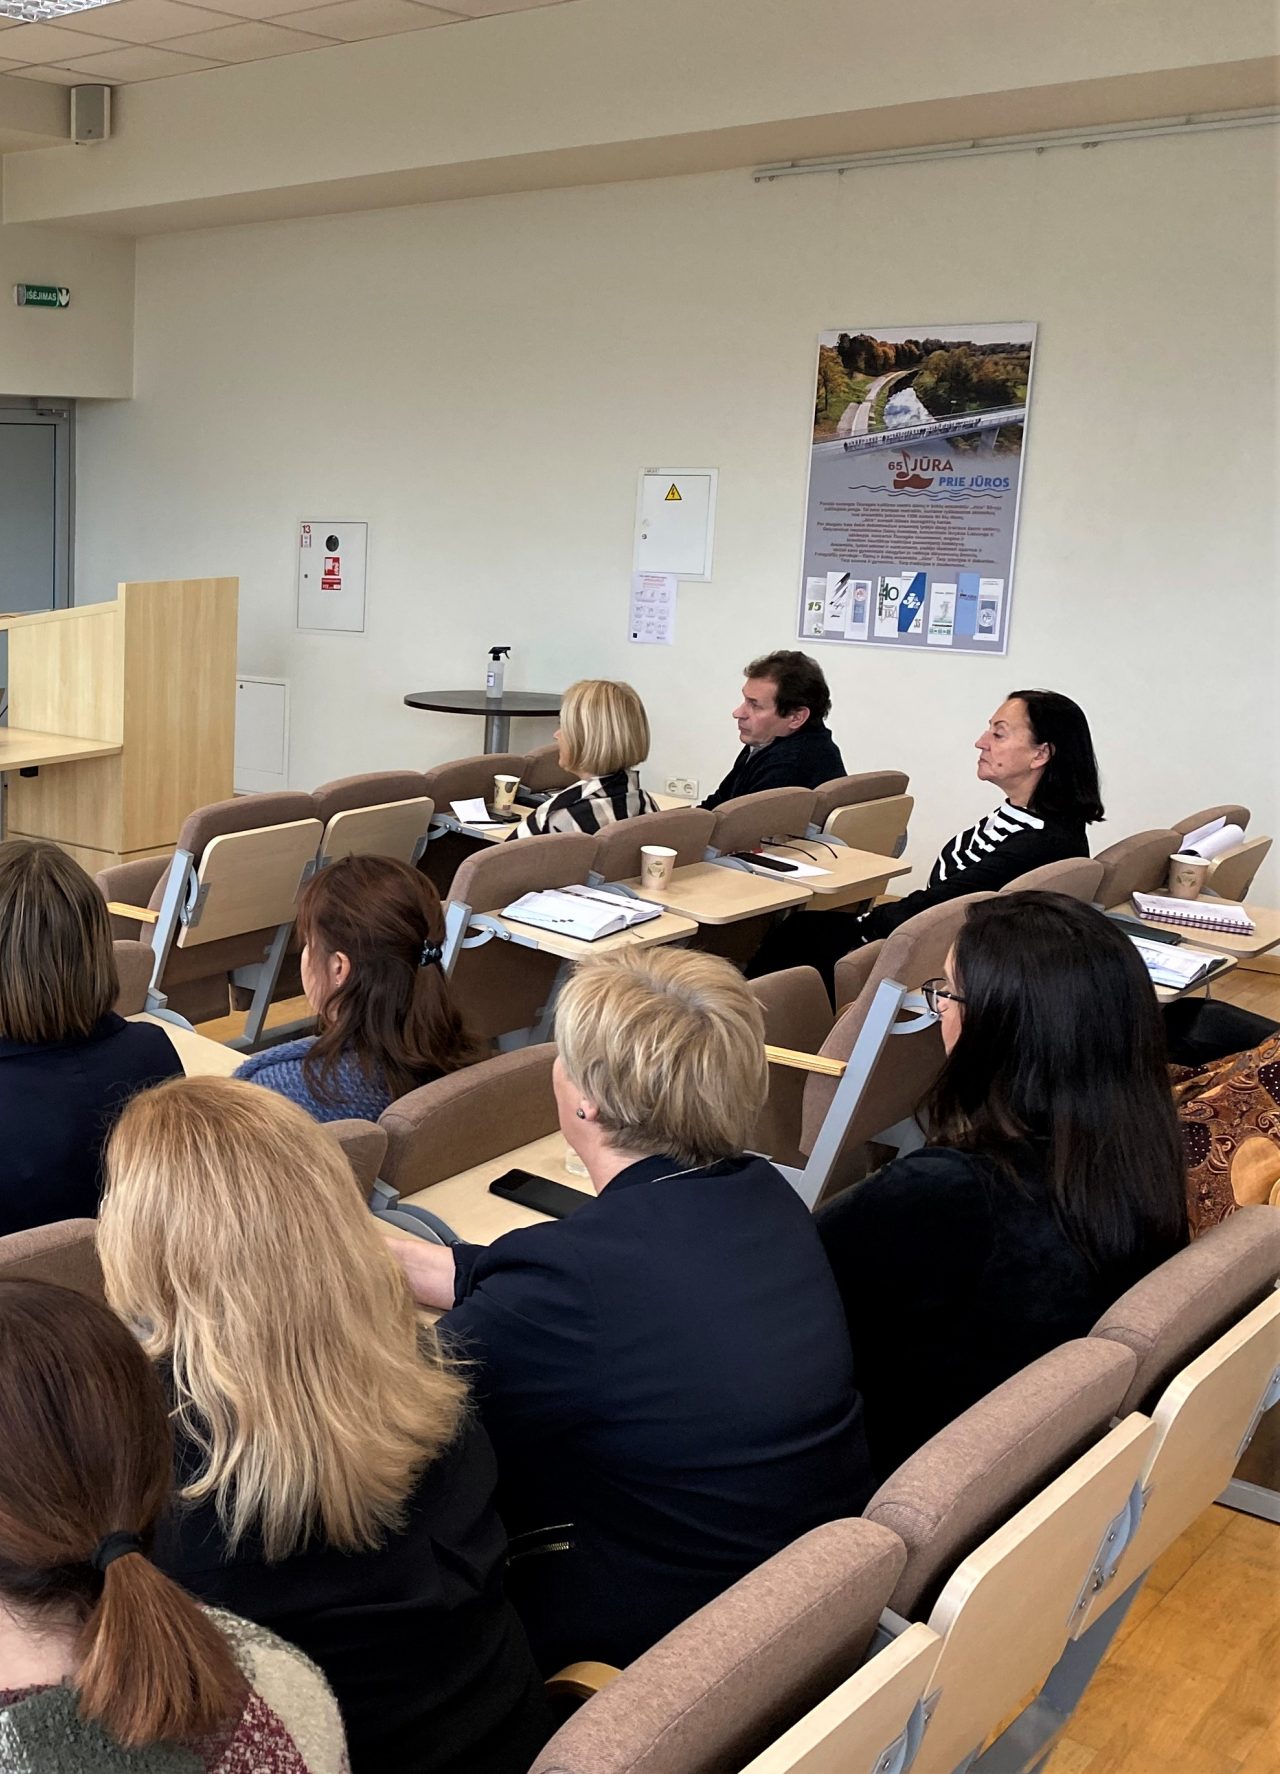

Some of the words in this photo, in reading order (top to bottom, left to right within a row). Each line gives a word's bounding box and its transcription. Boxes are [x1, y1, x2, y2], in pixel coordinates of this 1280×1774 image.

[888, 462, 903, 471] 65
[911, 456, 954, 472] JŪRA
[939, 476, 965, 487] PRIE
[969, 475, 1010, 488] JŪROS
[302, 524, 311, 534] 13
